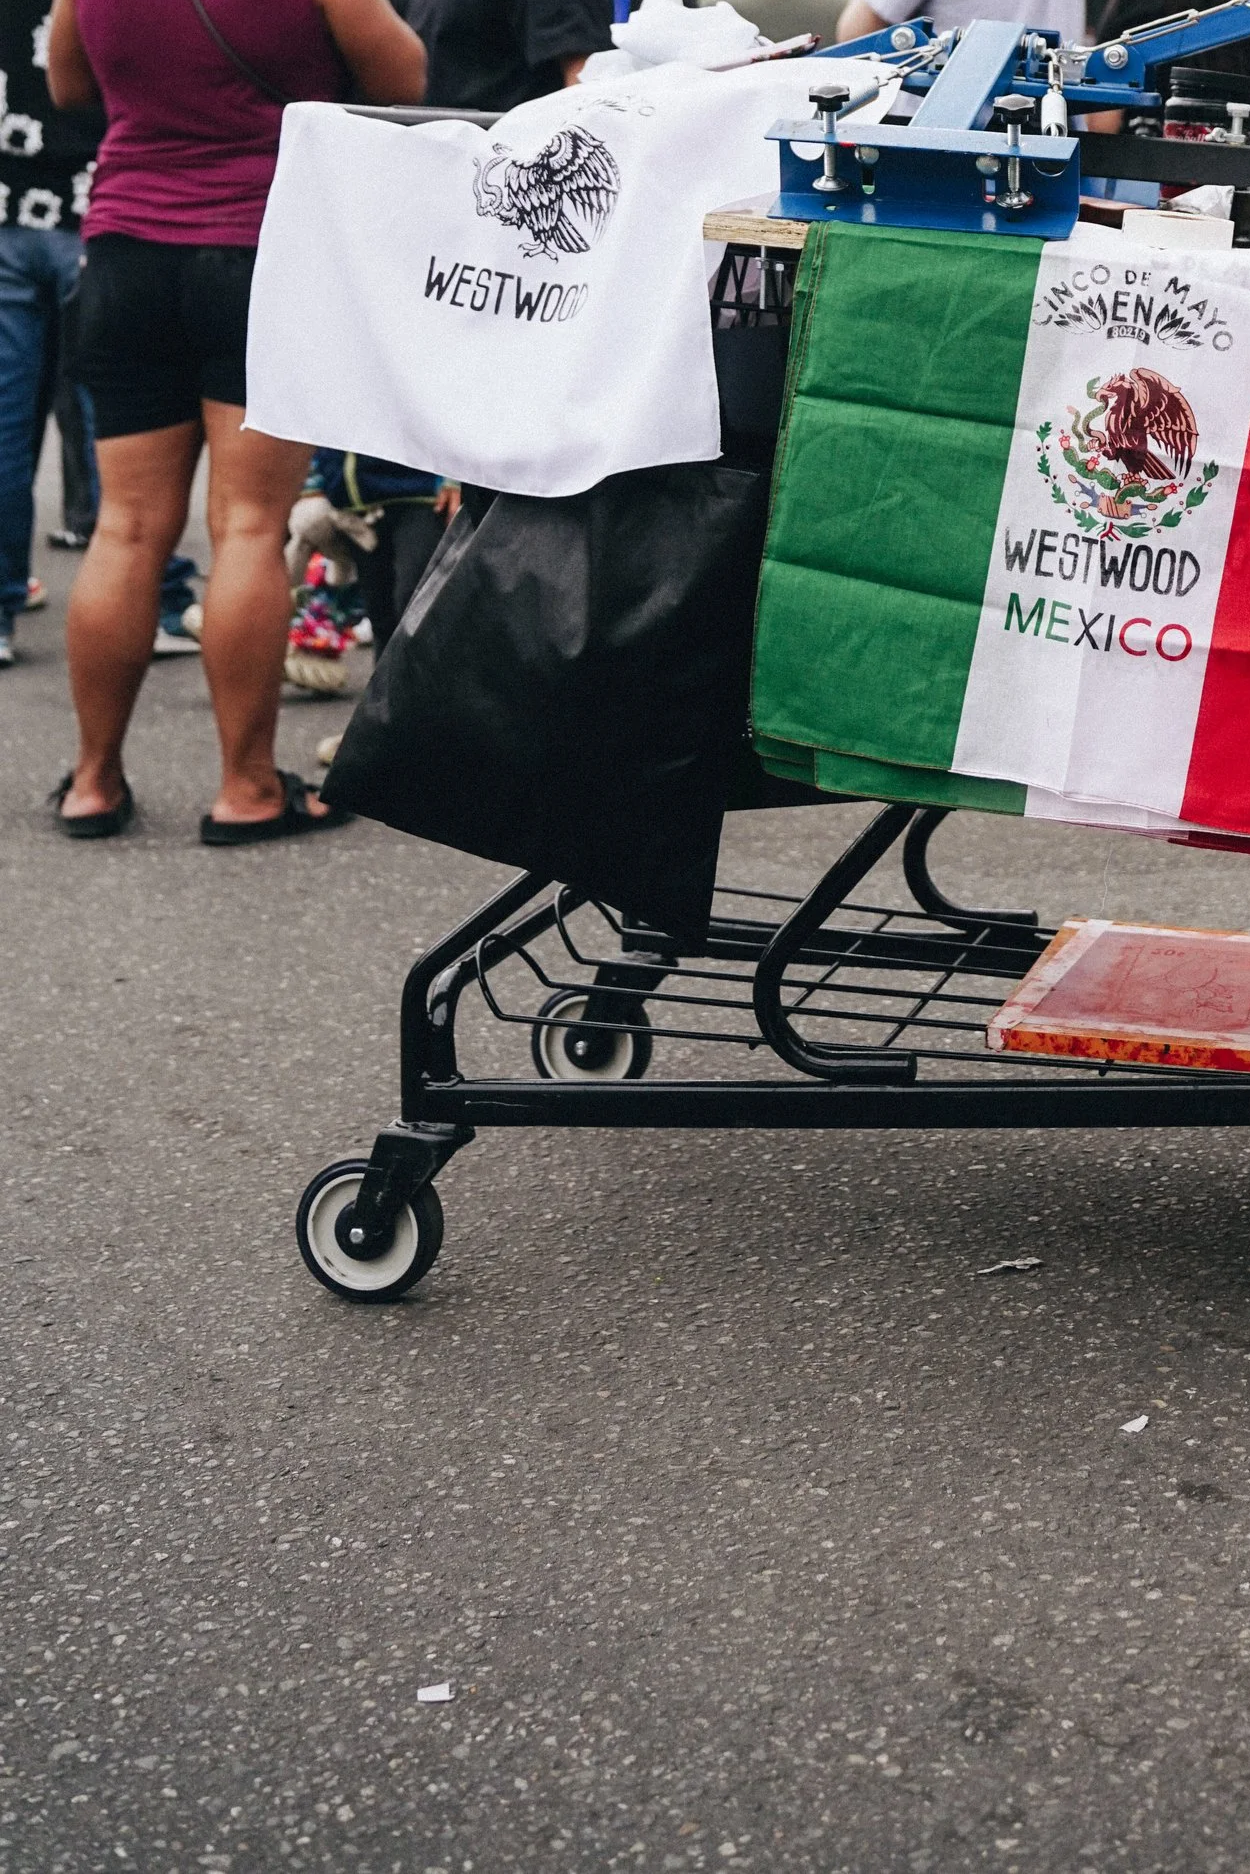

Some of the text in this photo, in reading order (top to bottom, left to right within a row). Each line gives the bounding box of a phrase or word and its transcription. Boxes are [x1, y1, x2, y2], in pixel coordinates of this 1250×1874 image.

[424, 255, 589, 323] WESTWOOD
[1031, 264, 1234, 352] CINCO DE MAYO
[1110, 290, 1155, 327] EN
[1111, 325, 1147, 342] 80219
[1004, 526, 1201, 598] WESTWOOD
[1003, 592, 1193, 662] MEXICO
